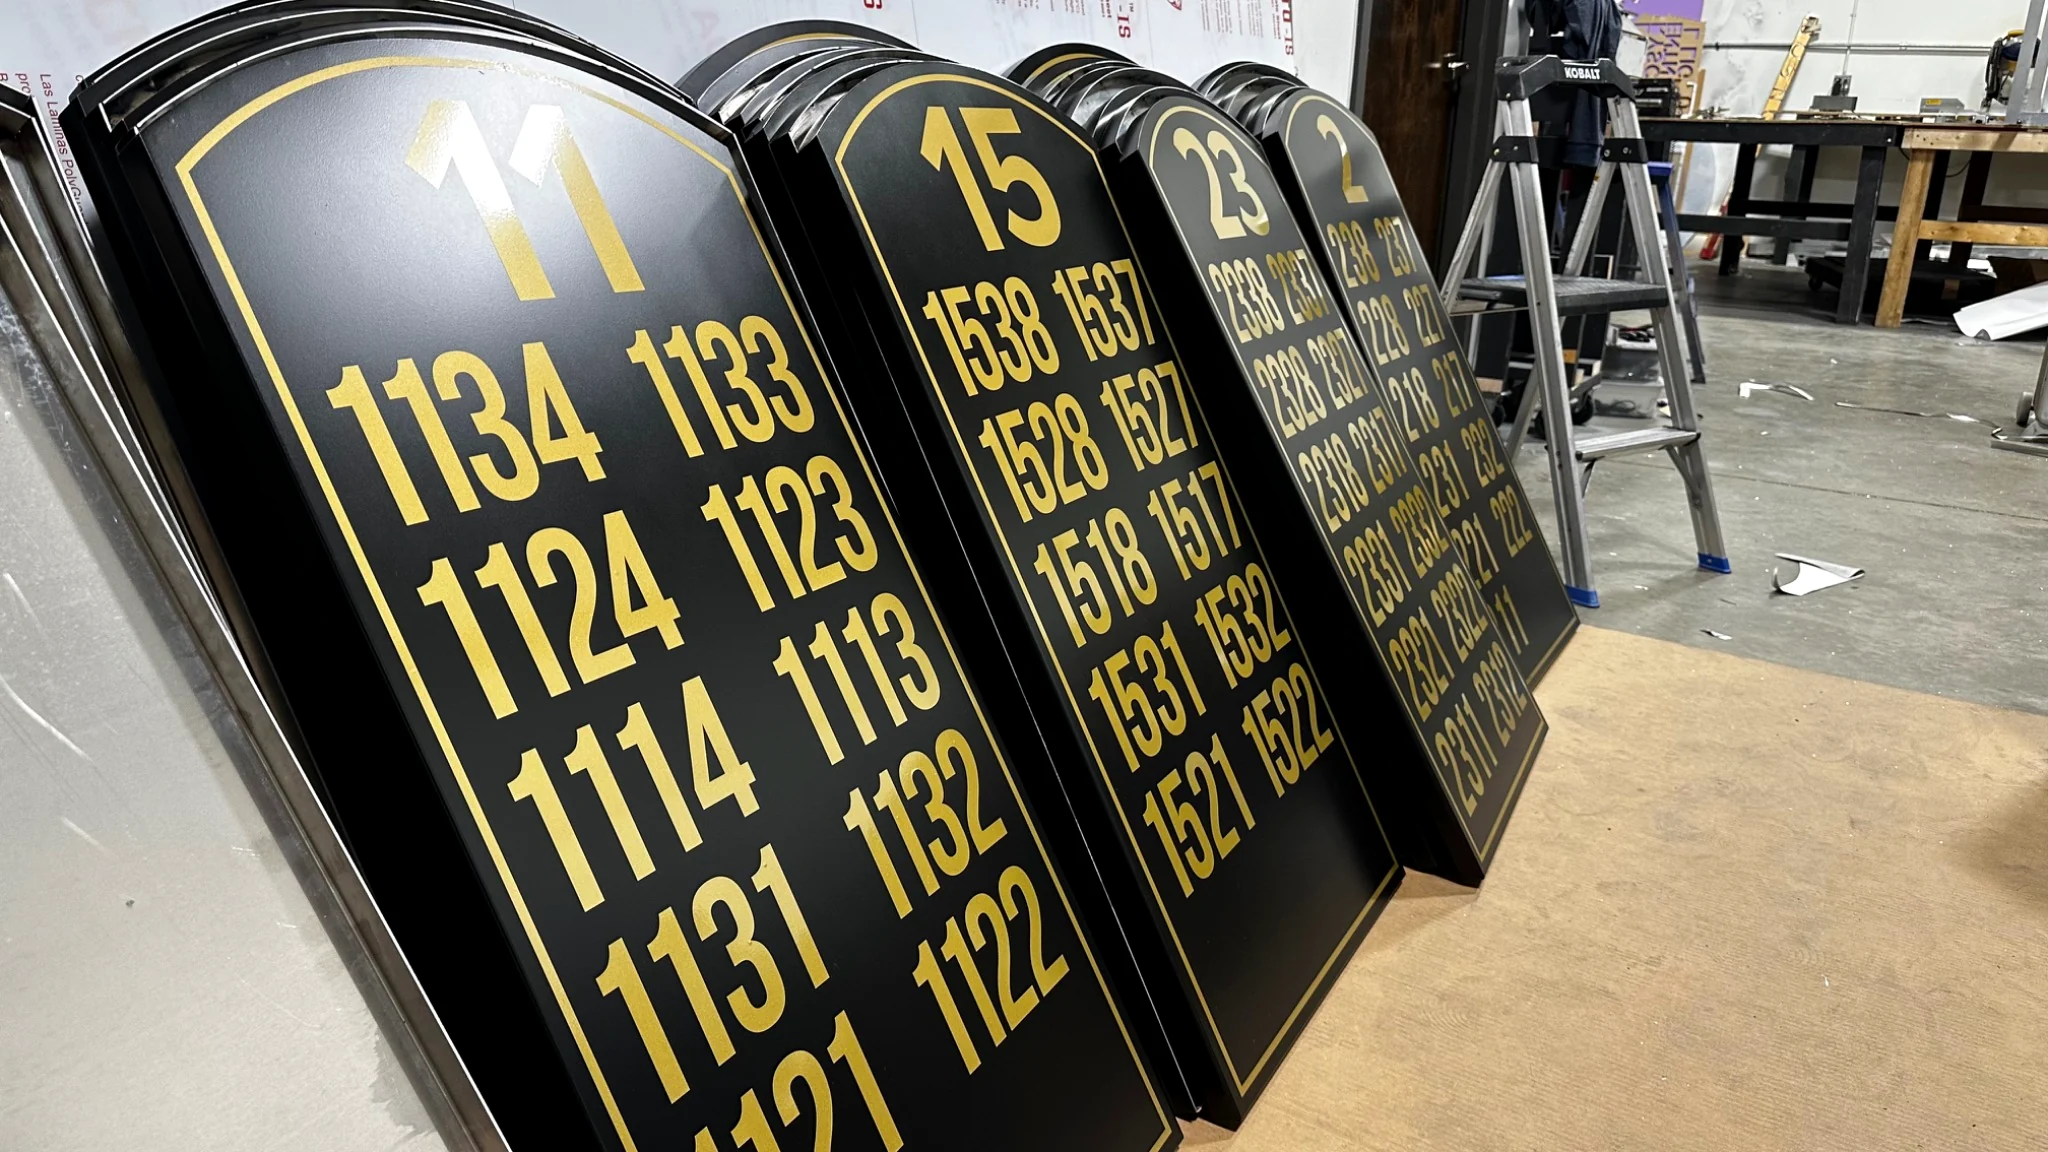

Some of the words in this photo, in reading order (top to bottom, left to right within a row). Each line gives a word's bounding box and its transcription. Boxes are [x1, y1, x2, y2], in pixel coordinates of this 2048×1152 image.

[40, 73, 53, 97] Las
[1564, 67, 1600, 80] KOBALT
[404, 99, 646, 301] 11
[920, 106, 1061, 251] 15
[1173, 127, 1270, 240] 23
[1316, 114, 1369, 204] 2
[1208, 257, 1285, 344] 2338
[1265, 249, 1330, 325] 2337
[1326, 220, 1380, 288] 238
[1374, 216, 1417, 277] 237
[922, 276, 1060, 397] 1538
[1051, 258, 1155, 362] 1537
[1253, 345, 1327, 439] 2328
[1307, 327, 1368, 410] 2327
[1357, 294, 1410, 366] 228
[1402, 283, 1445, 347] 227
[325, 341, 606, 526] 1134
[626, 315, 815, 458] 1133
[978, 392, 1109, 523] 1528
[1100, 360, 1198, 472] 1527
[1387, 367, 1440, 442] 218
[1432, 350, 1474, 418] 217
[1298, 433, 1369, 533] 2318
[1348, 406, 1407, 494] 2317
[1419, 439, 1470, 518] 231
[1460, 417, 1505, 488] 232
[1490, 484, 1533, 558] 222
[416, 509, 685, 719] 1124
[701, 455, 878, 612] 1123
[1033, 507, 1158, 648] 1518
[1147, 460, 1242, 581] 1517
[1343, 519, 1412, 628] 2331
[1389, 484, 1450, 579] 2332
[1487, 585, 1529, 656] 11
[1087, 620, 1207, 773] 1531
[1194, 563, 1292, 690] 1532
[1389, 606, 1455, 723] 2321
[1430, 563, 1489, 664] 2322
[507, 675, 760, 912] 1114
[773, 592, 941, 765] 1113
[1142, 733, 1256, 898] 1521
[1241, 662, 1334, 798] 1522
[1435, 692, 1498, 818] 2311
[1473, 641, 1528, 748] 2312
[595, 843, 830, 1104] 1131
[842, 729, 1008, 919] 1132
[693, 1010, 904, 1152] 21
[912, 865, 1070, 1075] 1122
